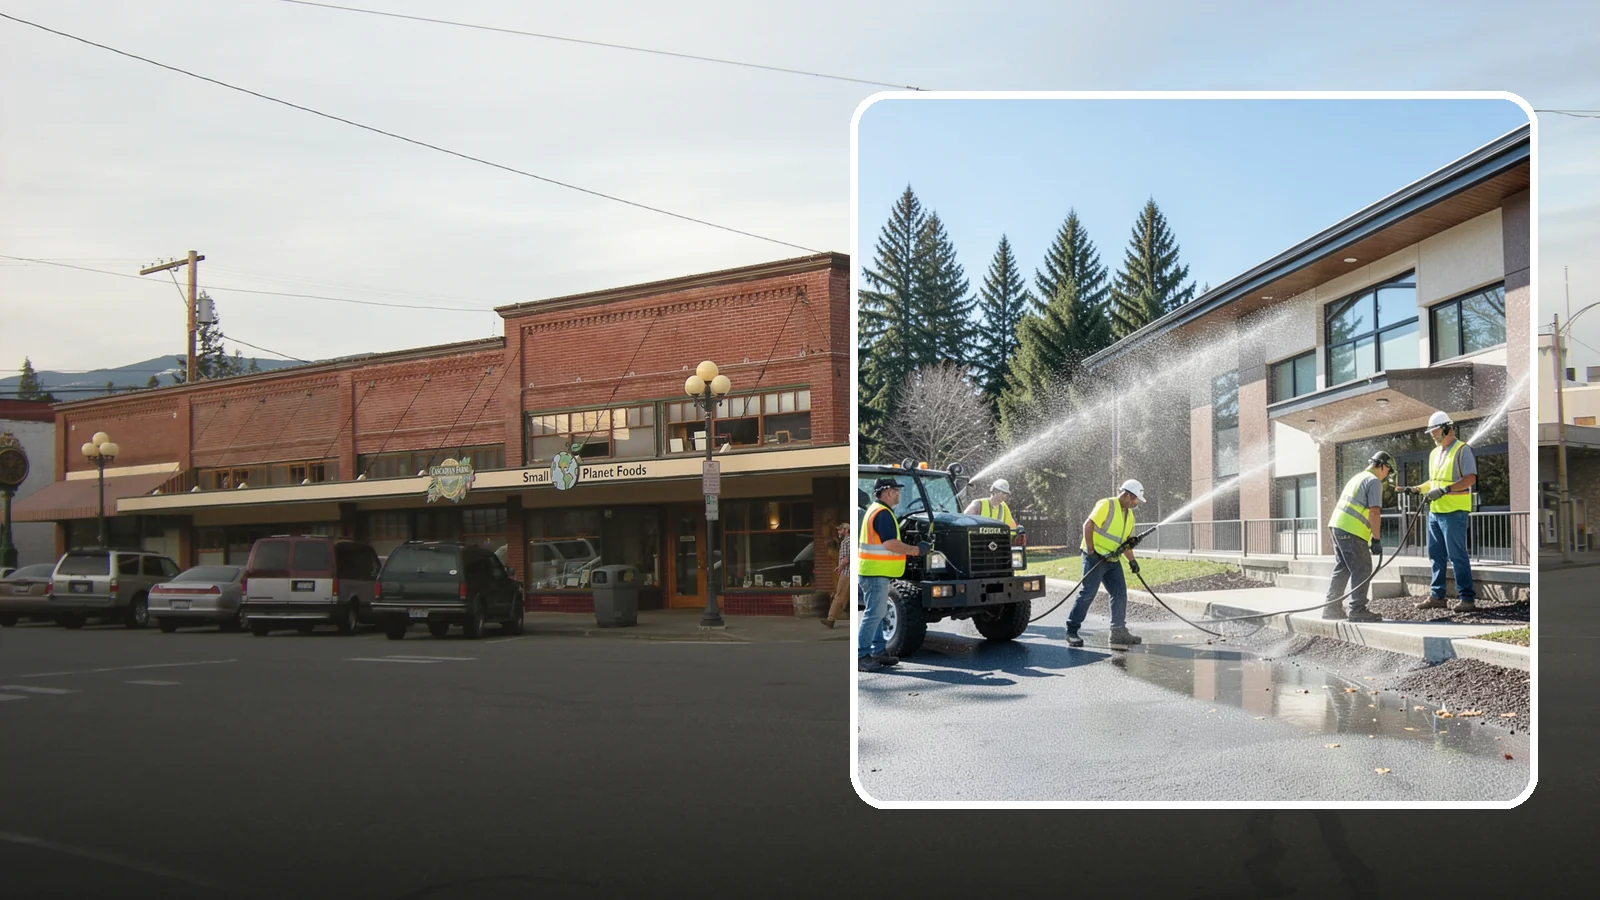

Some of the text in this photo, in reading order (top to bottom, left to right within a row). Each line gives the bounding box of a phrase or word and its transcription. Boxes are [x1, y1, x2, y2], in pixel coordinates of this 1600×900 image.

[523, 464, 646, 482] Small Planet Foods
